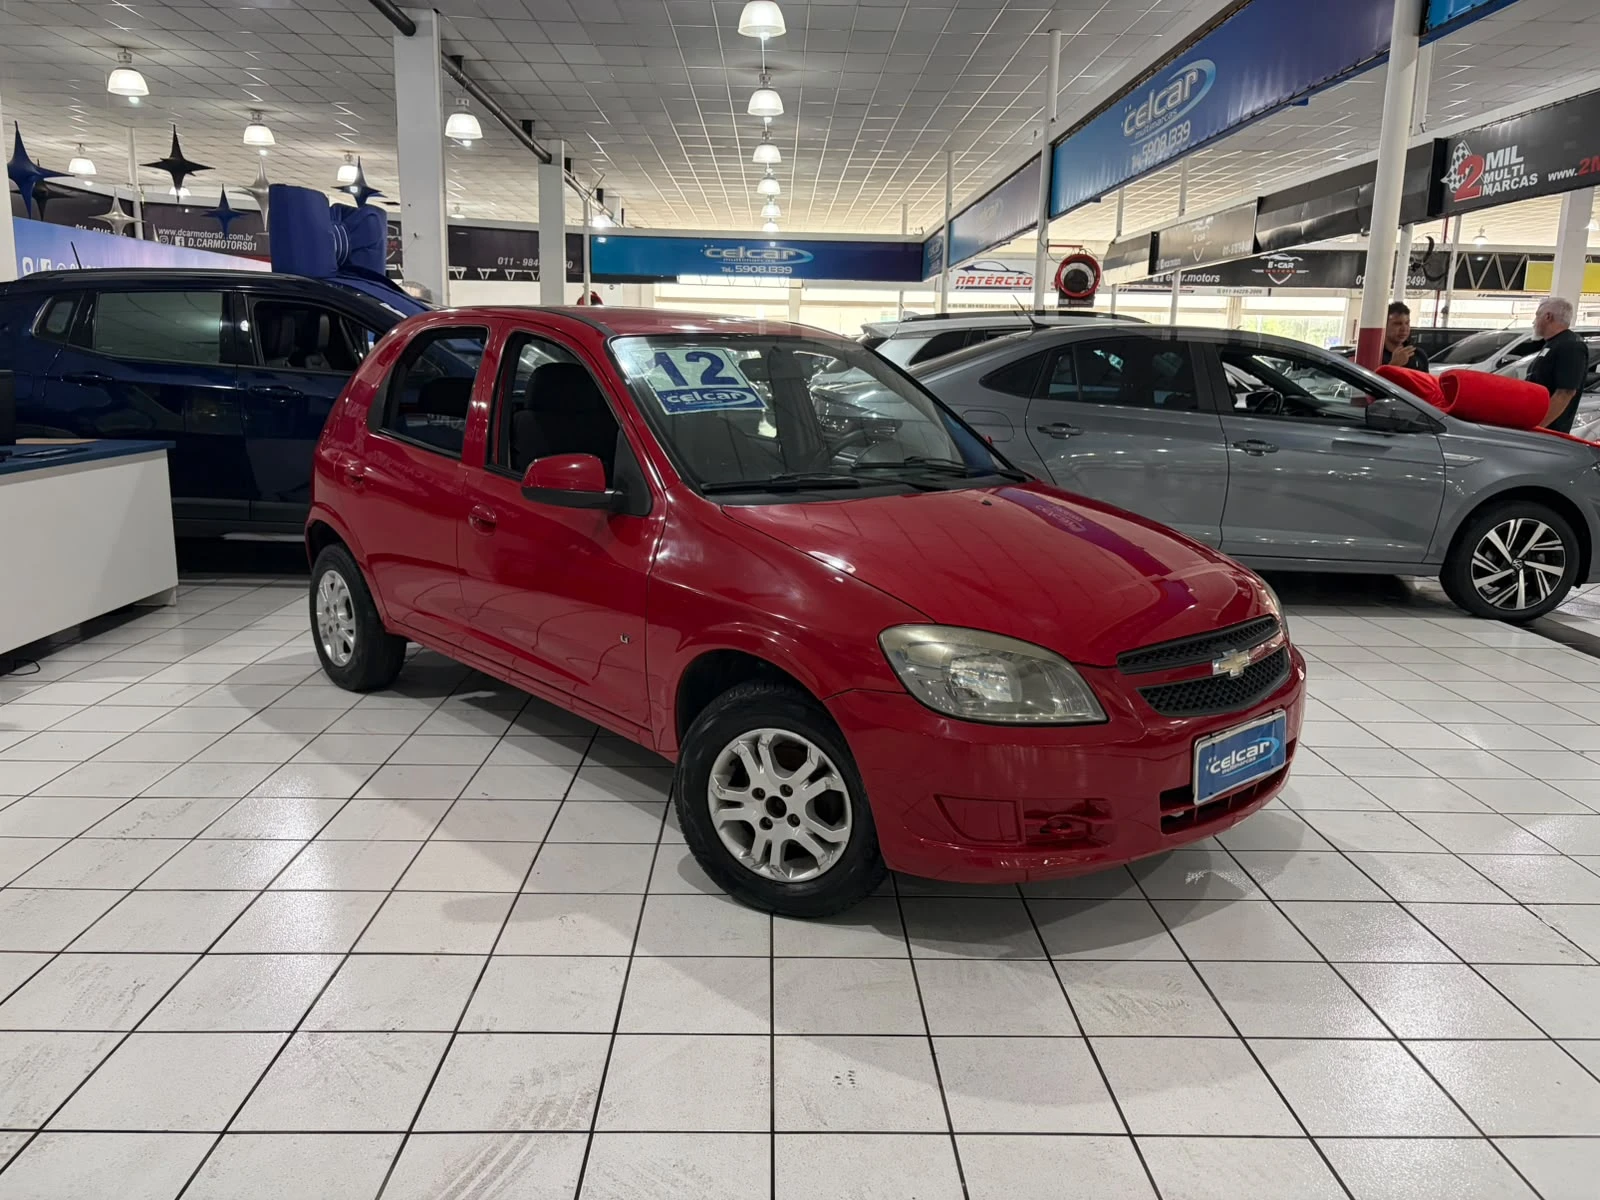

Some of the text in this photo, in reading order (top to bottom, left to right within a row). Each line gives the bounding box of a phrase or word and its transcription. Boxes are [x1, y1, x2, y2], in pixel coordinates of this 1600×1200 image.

[1123, 69, 1198, 137] celcar
[1454, 145, 1524, 202] 2 MIL
[1483, 164, 1525, 184] MULTI
[1483, 173, 1538, 196] MARCAS
[158, 228, 253, 241] www.dcarmotors0.com.br
[188, 238, 257, 251] D.CARMOTORS01
[497, 257, 513, 266] 011
[704, 246, 797, 260] celcar
[646, 351, 740, 387] 12
[665, 391, 742, 403] celcar
[1209, 741, 1270, 774] celcar
